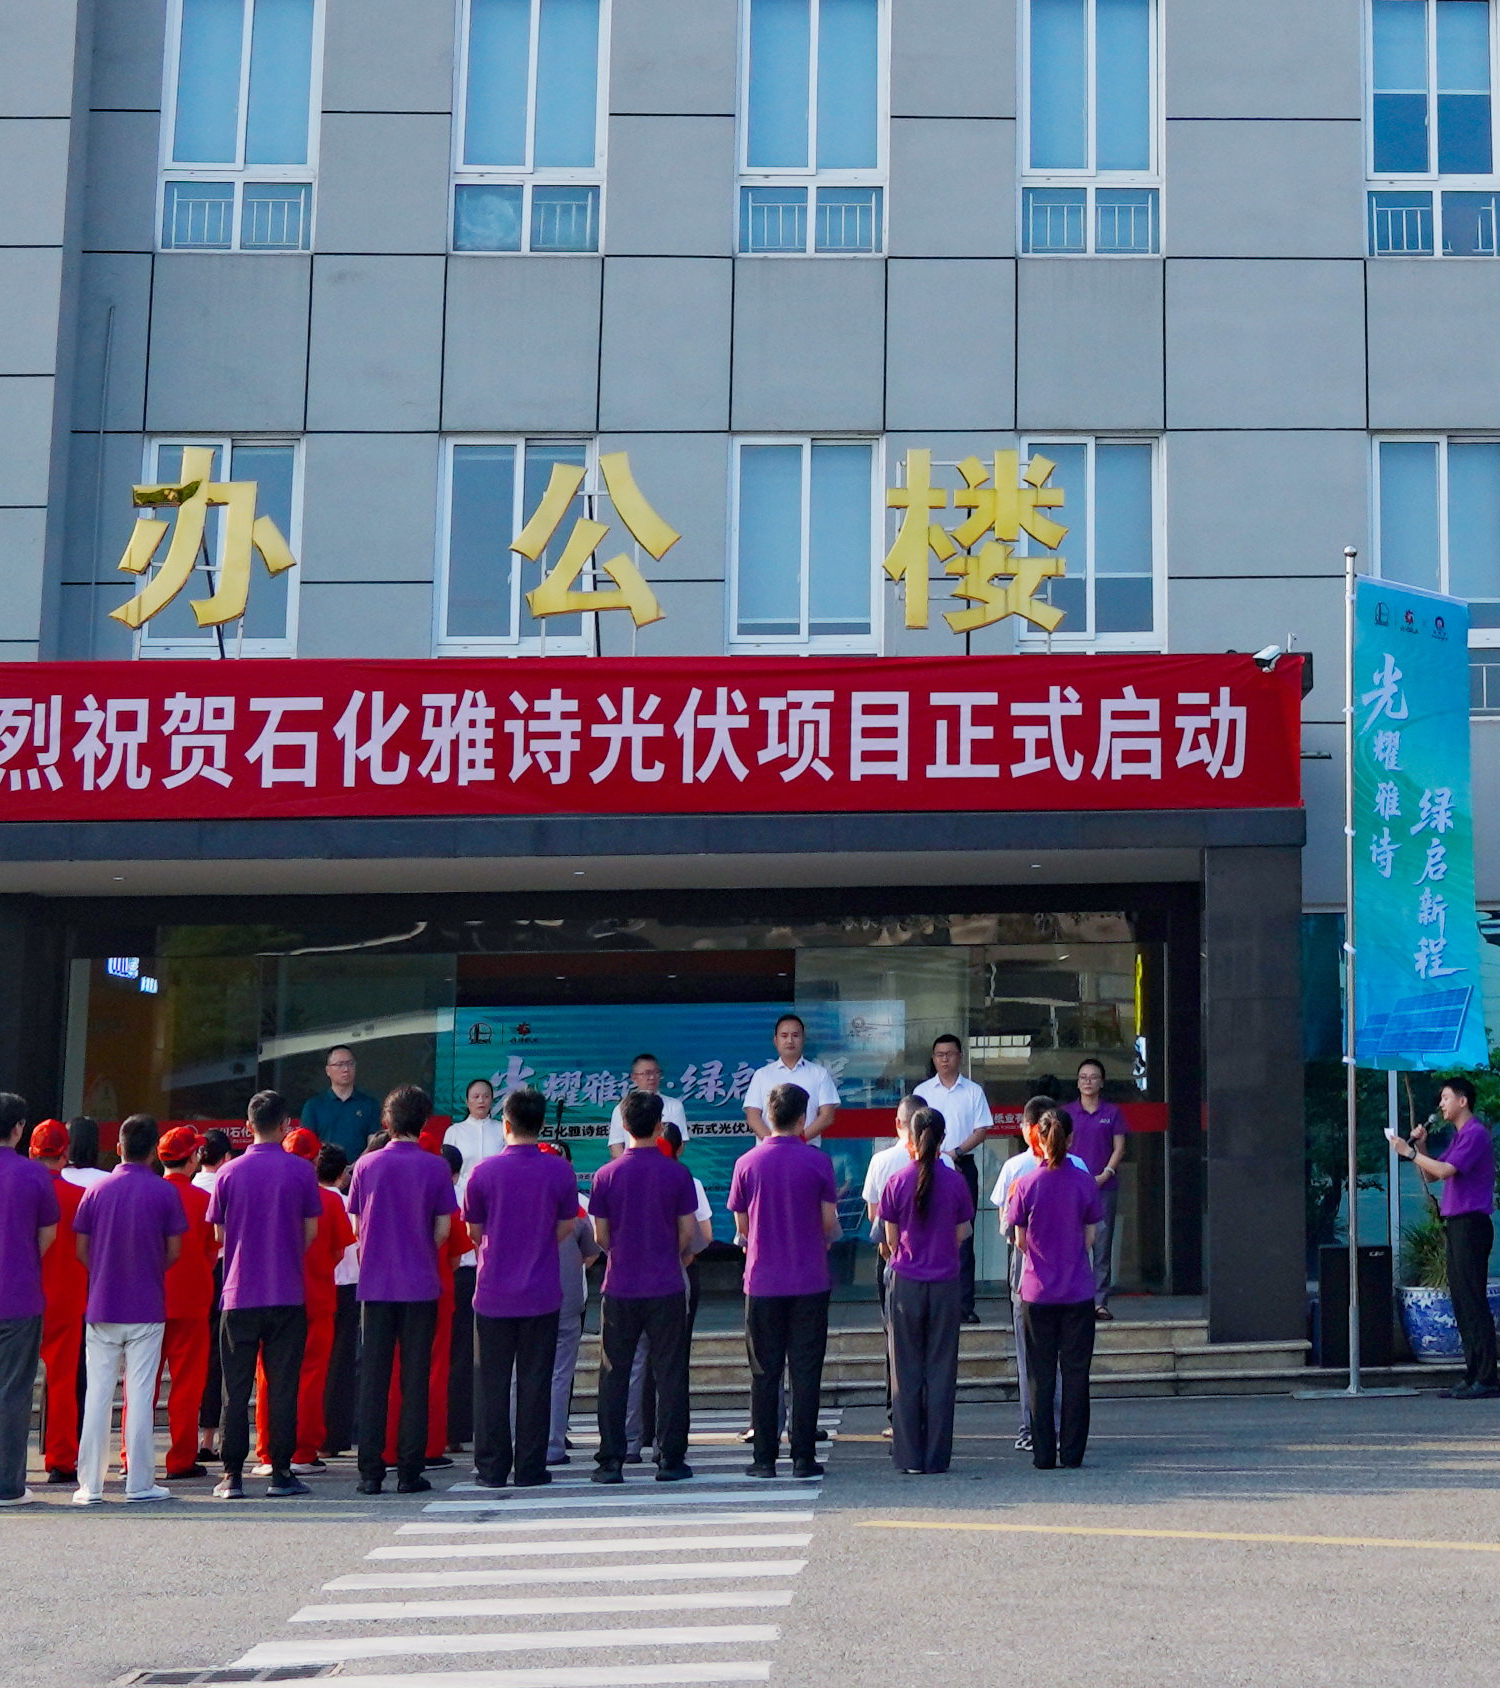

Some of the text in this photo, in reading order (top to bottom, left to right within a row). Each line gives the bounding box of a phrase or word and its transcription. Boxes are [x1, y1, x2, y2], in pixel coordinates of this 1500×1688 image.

[108, 446, 1070, 635] 办公楼
[1357, 653, 1410, 881] 光耀雅诗
[1409, 787, 1469, 980] 绿启新程
